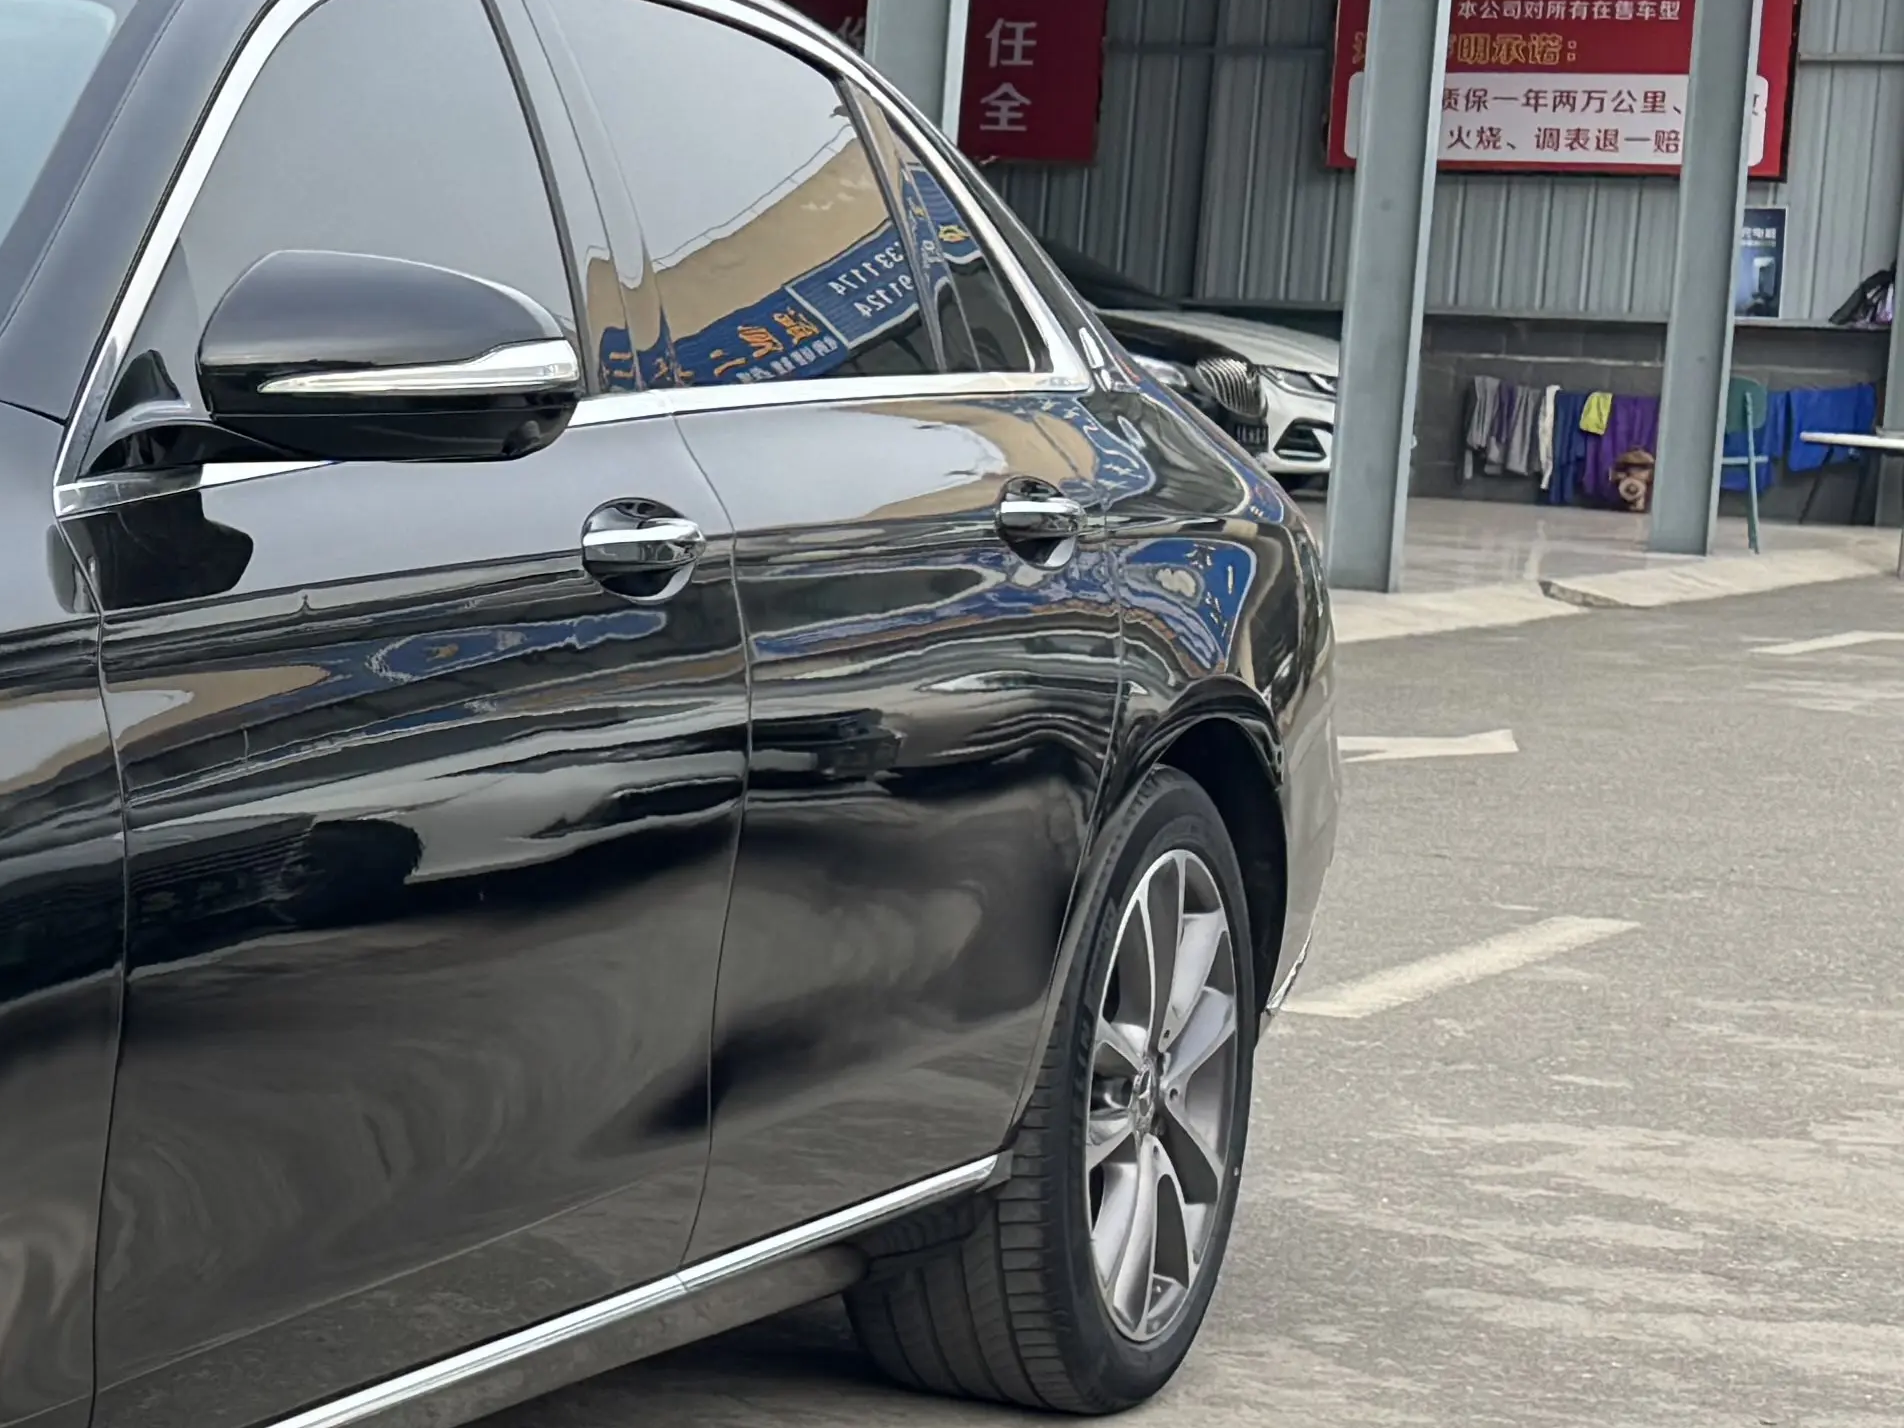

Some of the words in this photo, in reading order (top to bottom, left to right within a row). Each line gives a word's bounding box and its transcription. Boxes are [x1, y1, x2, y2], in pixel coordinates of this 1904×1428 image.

[1457, 0, 1681, 21] 本公司对所有在售车型
[985, 18, 1037, 68] 任
[1450, 33, 1576, 65] 明承诺：
[980, 82, 1031, 131] 全
